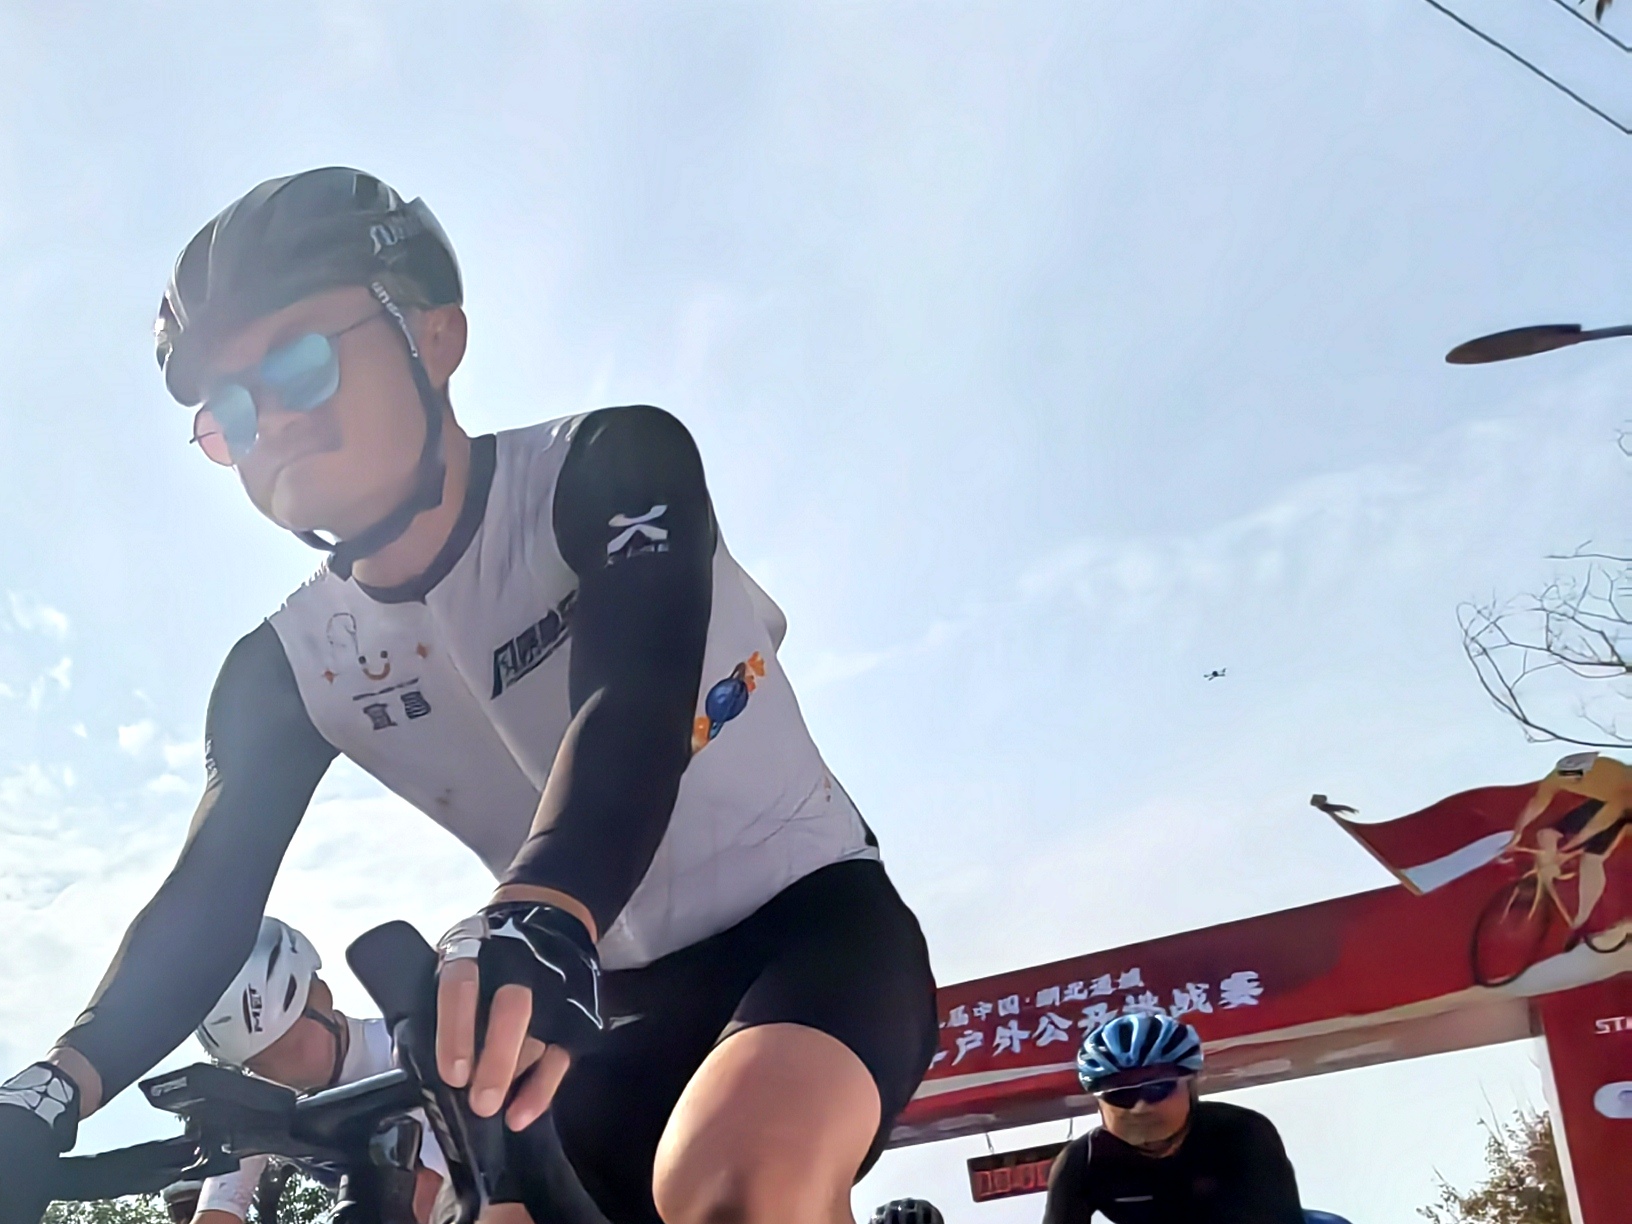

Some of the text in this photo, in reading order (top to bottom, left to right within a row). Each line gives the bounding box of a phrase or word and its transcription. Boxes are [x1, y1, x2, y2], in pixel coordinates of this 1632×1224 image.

[928, 970, 1264, 1070] 户外公开挑战赛
[1594, 1015, 1632, 1035] ST
